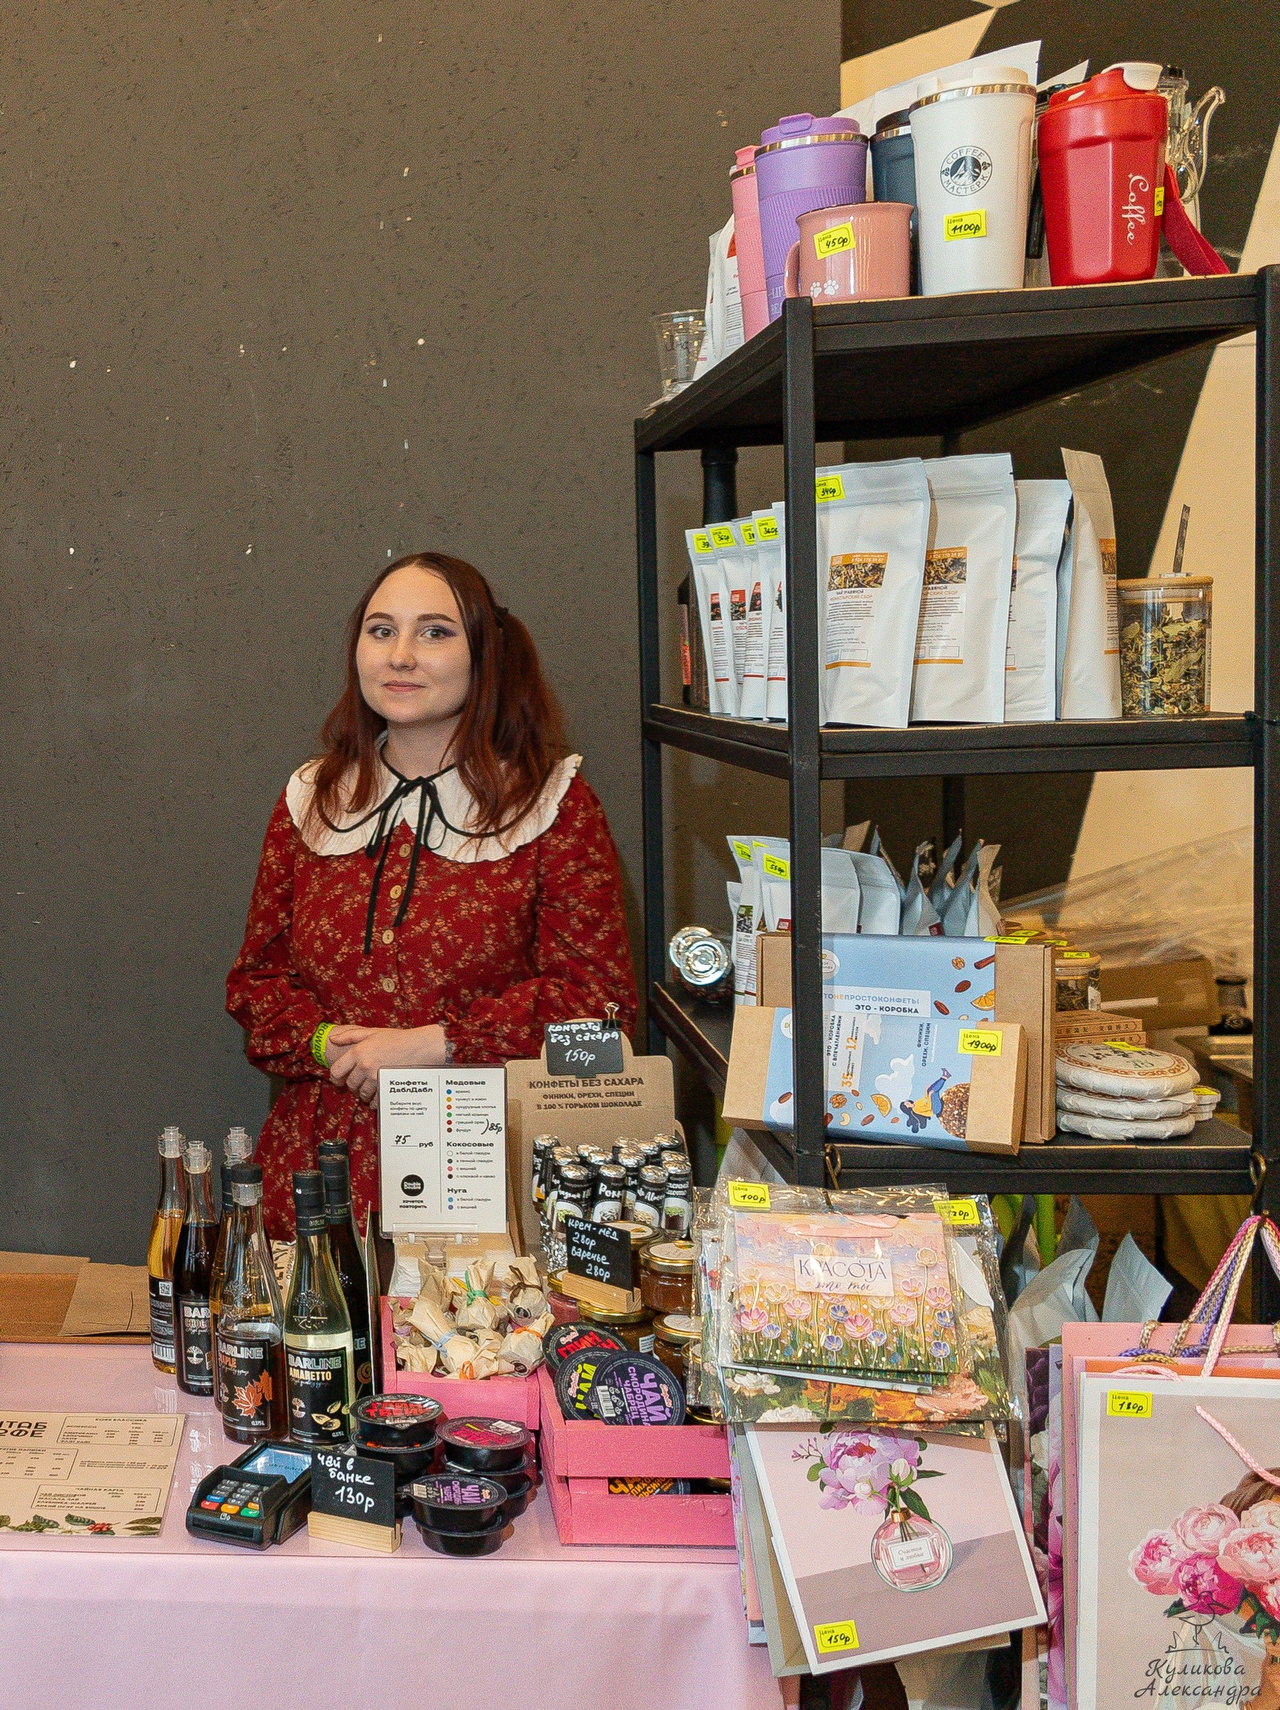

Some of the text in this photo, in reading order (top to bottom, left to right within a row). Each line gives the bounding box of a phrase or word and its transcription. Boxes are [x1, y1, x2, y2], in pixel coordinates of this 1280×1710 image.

[946, 148, 985, 165] COFFEE
[1121, 173, 1150, 246] Coffee
[879, 1006, 920, 1014] КОРОБКА
[846, 1037, 858, 1051] 12
[967, 1040, 997, 1053] 1900р
[564, 1049, 596, 1067] 150р
[530, 1078, 644, 1089] КОНФЕТЫ БЕЗ САХАРА
[395, 1135, 411, 1145] 75
[572, 1232, 597, 1248] 280р
[586, 1264, 611, 1282] 280р
[288, 1354, 342, 1370] BARLINE
[289, 1368, 332, 1381] AMARETTO
[625, 1379, 641, 1420] ЧАБРЕЦ
[639, 1372, 671, 1422] ЧАЙ
[317, 1452, 343, 1467] чай
[346, 1458, 355, 1472] в
[329, 1468, 375, 1486] банке
[335, 1486, 375, 1513] 130р
[827, 1633, 850, 1645] 150р
